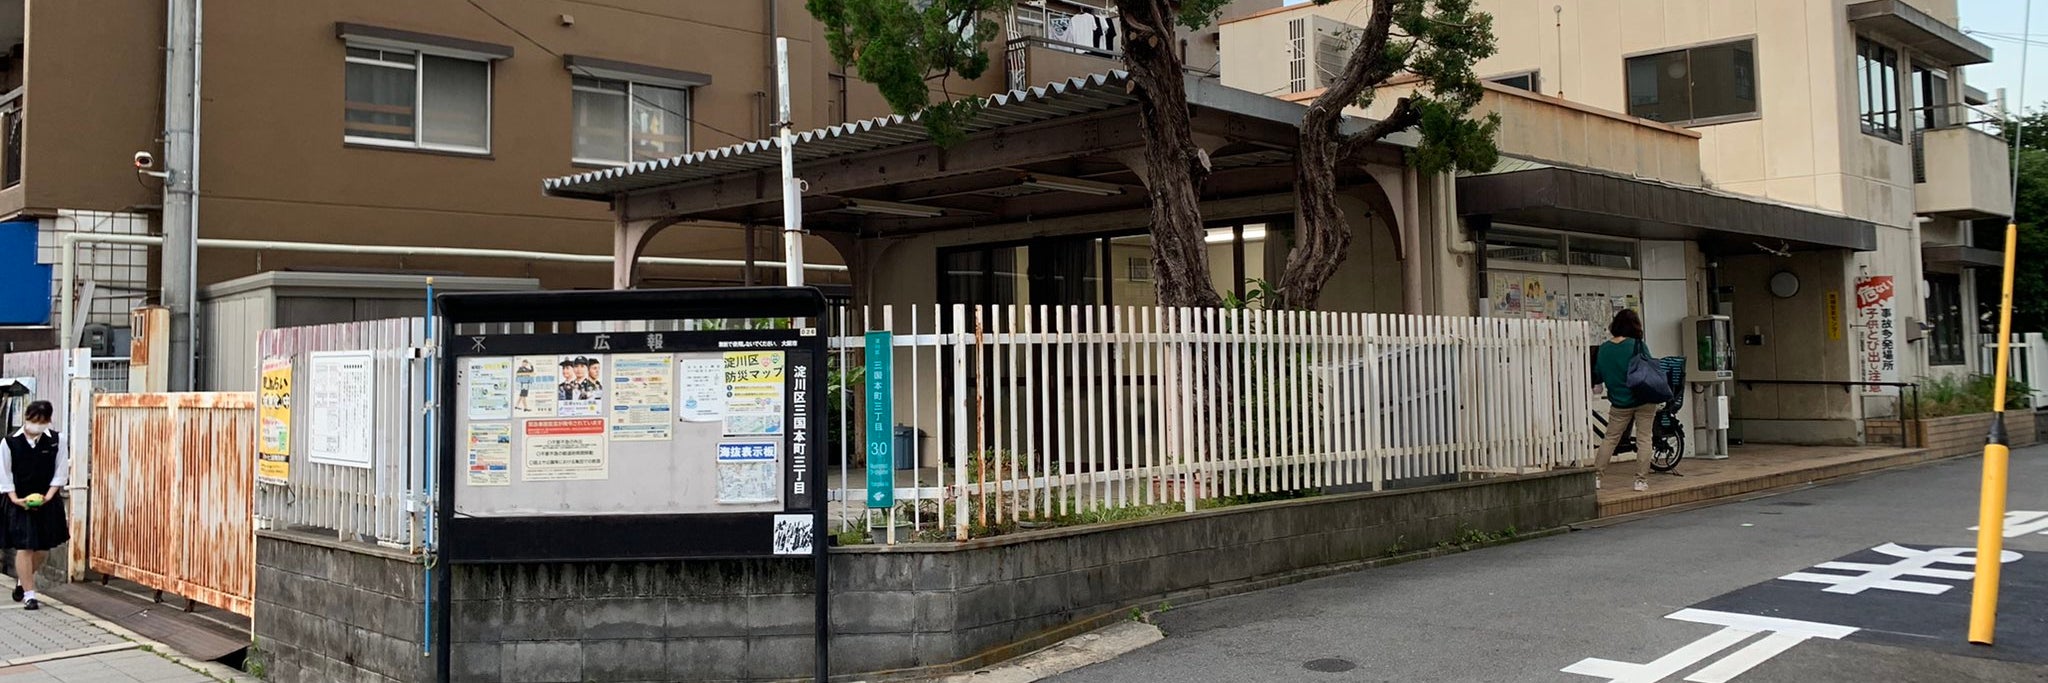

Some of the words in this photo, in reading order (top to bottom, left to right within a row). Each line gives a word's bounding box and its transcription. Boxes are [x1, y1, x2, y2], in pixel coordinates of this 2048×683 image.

[724, 354, 760, 369] 淀川区
[725, 367, 783, 384] 防災マップ
[873, 361, 883, 431] 三国本町三丁目
[793, 365, 806, 494] 淀川区三国本町三丁目
[719, 445, 775, 459] 海抜表示板
[870, 441, 888, 456] 30
